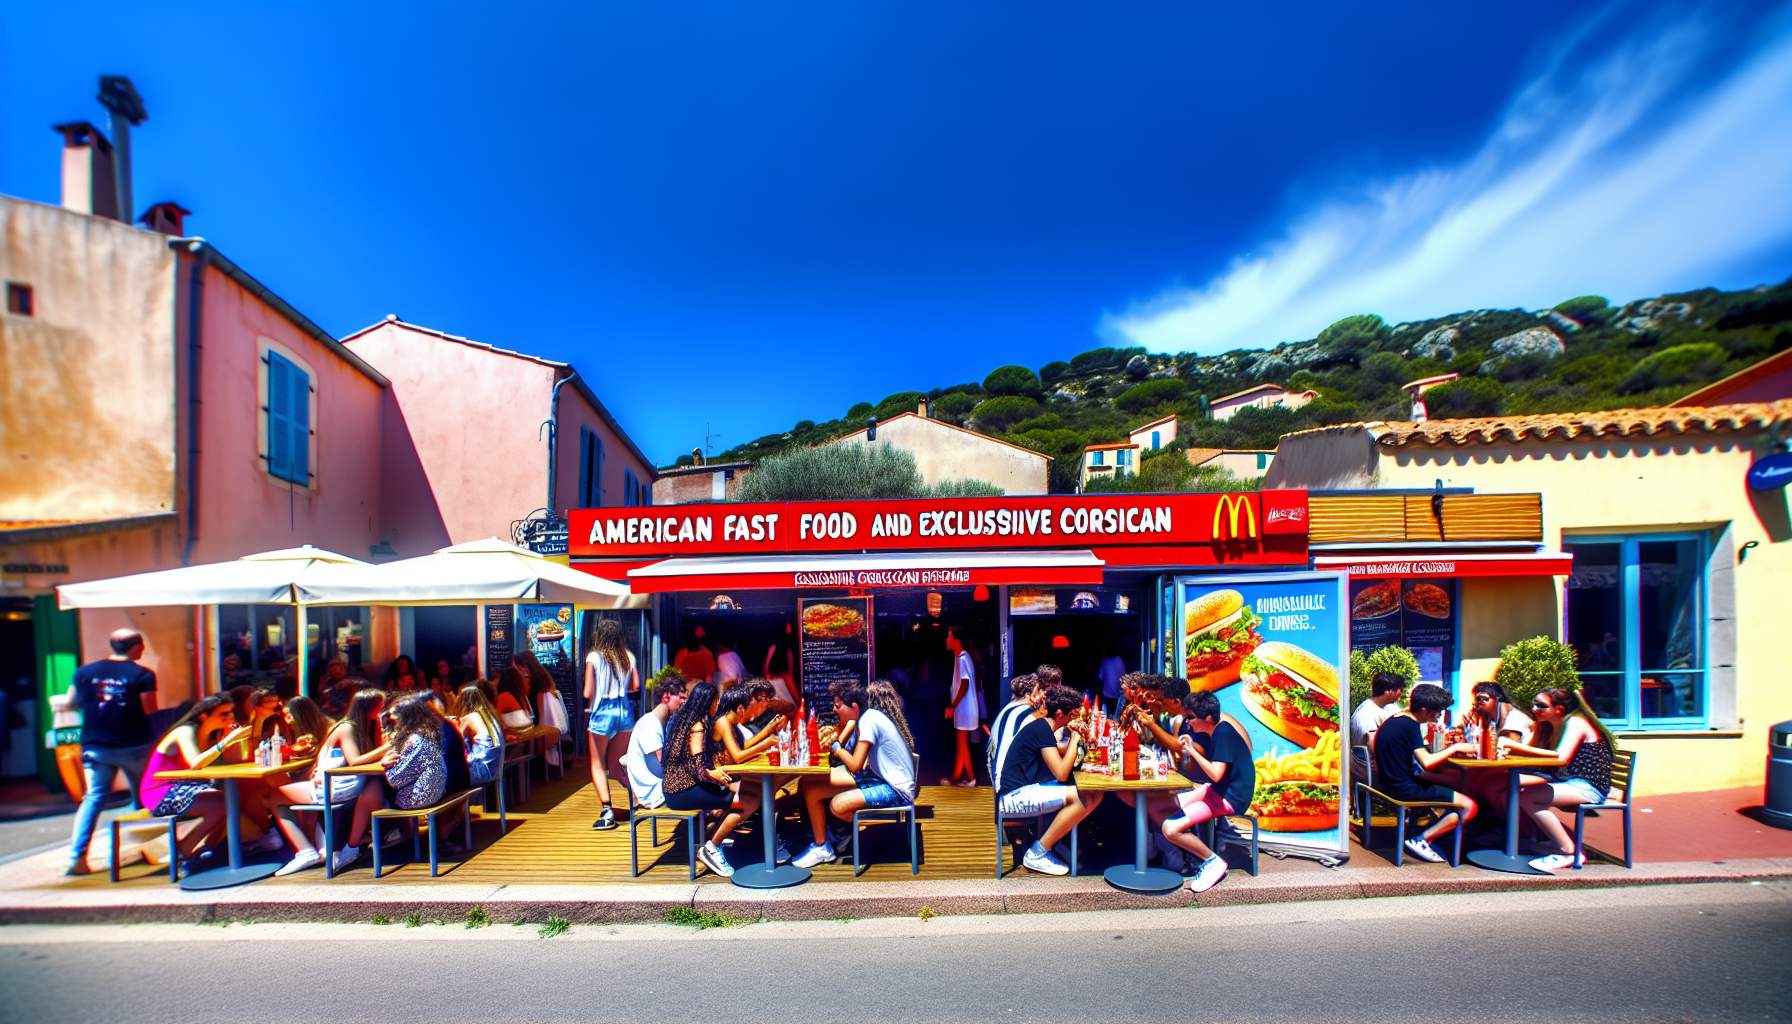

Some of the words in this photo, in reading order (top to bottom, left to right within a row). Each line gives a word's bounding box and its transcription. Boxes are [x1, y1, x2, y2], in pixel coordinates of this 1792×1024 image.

[589, 516, 713, 545] AMERICAN
[723, 514, 779, 541] FAST
[800, 512, 857, 539] FOOD
[871, 513, 912, 538] AND
[1059, 506, 1172, 534] CORSICAN
